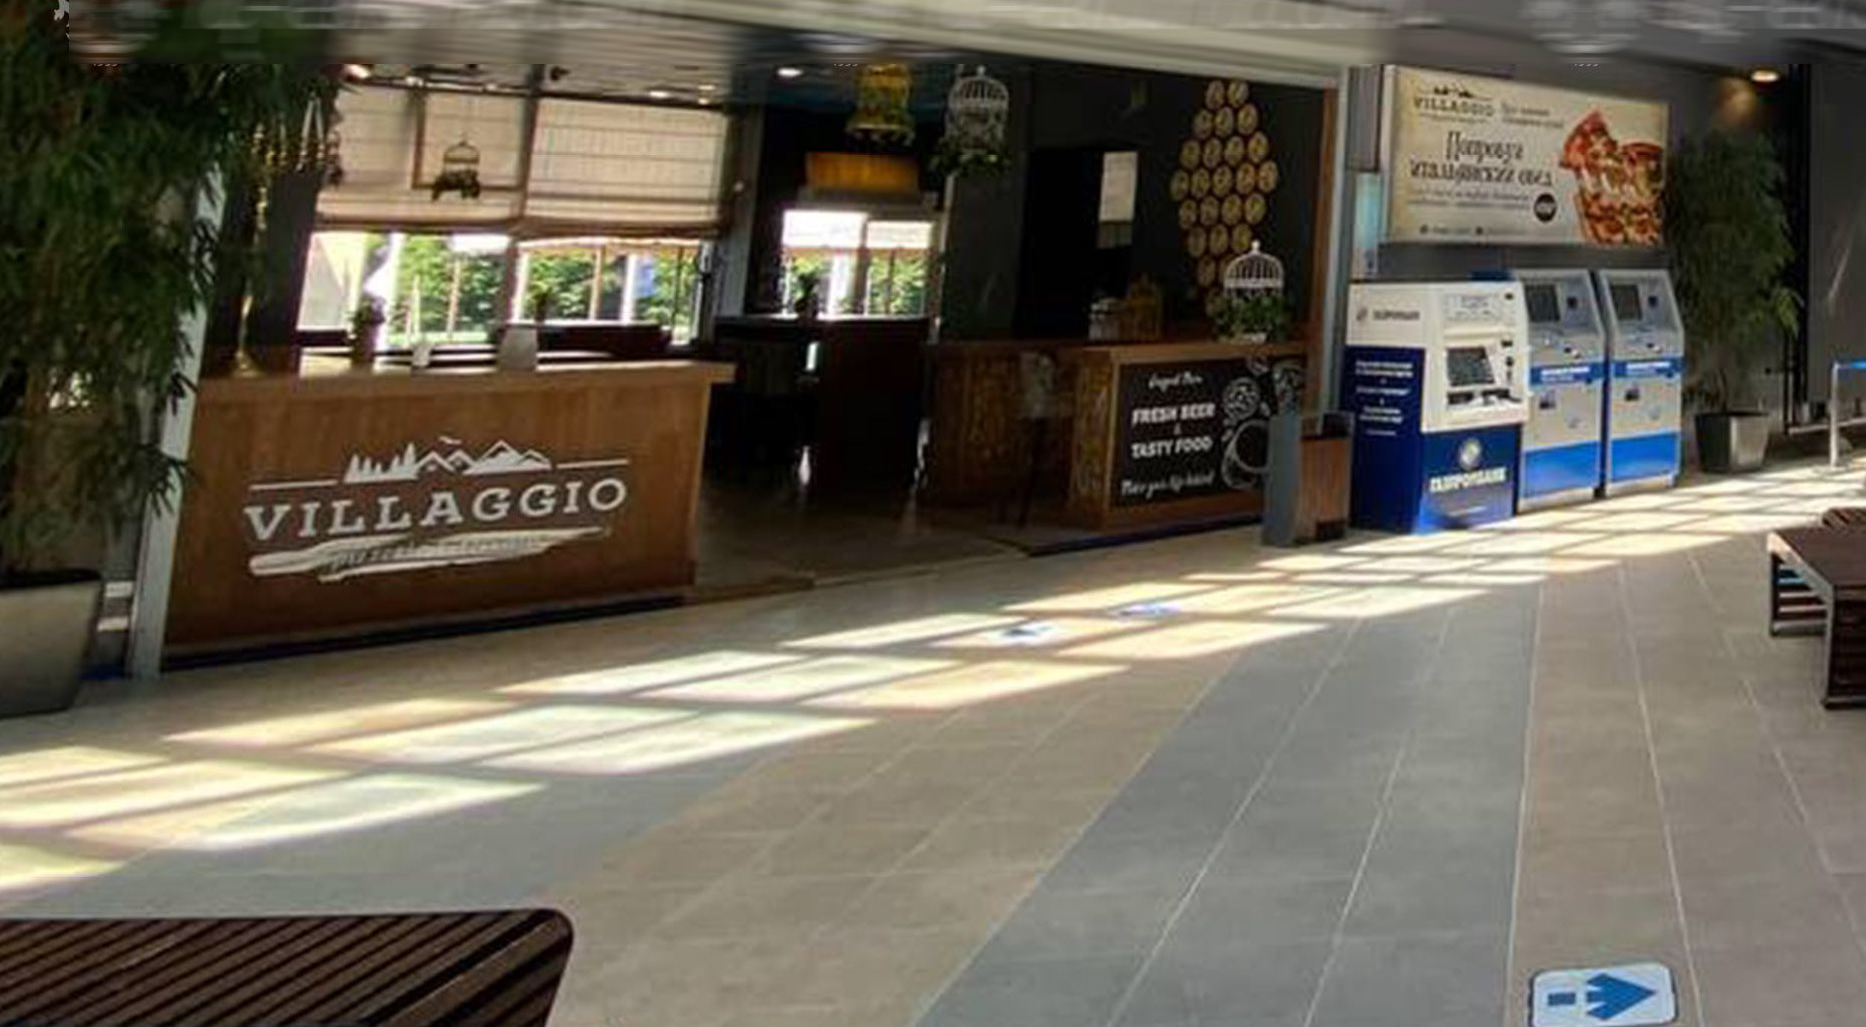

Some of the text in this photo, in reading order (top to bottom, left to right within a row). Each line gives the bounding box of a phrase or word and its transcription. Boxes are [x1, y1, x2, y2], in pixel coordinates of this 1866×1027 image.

[1131, 402, 1216, 425] FRESH BEER
[1131, 435, 1214, 459] TASTY FOOD
[243, 477, 628, 541] VILLAGGIO
